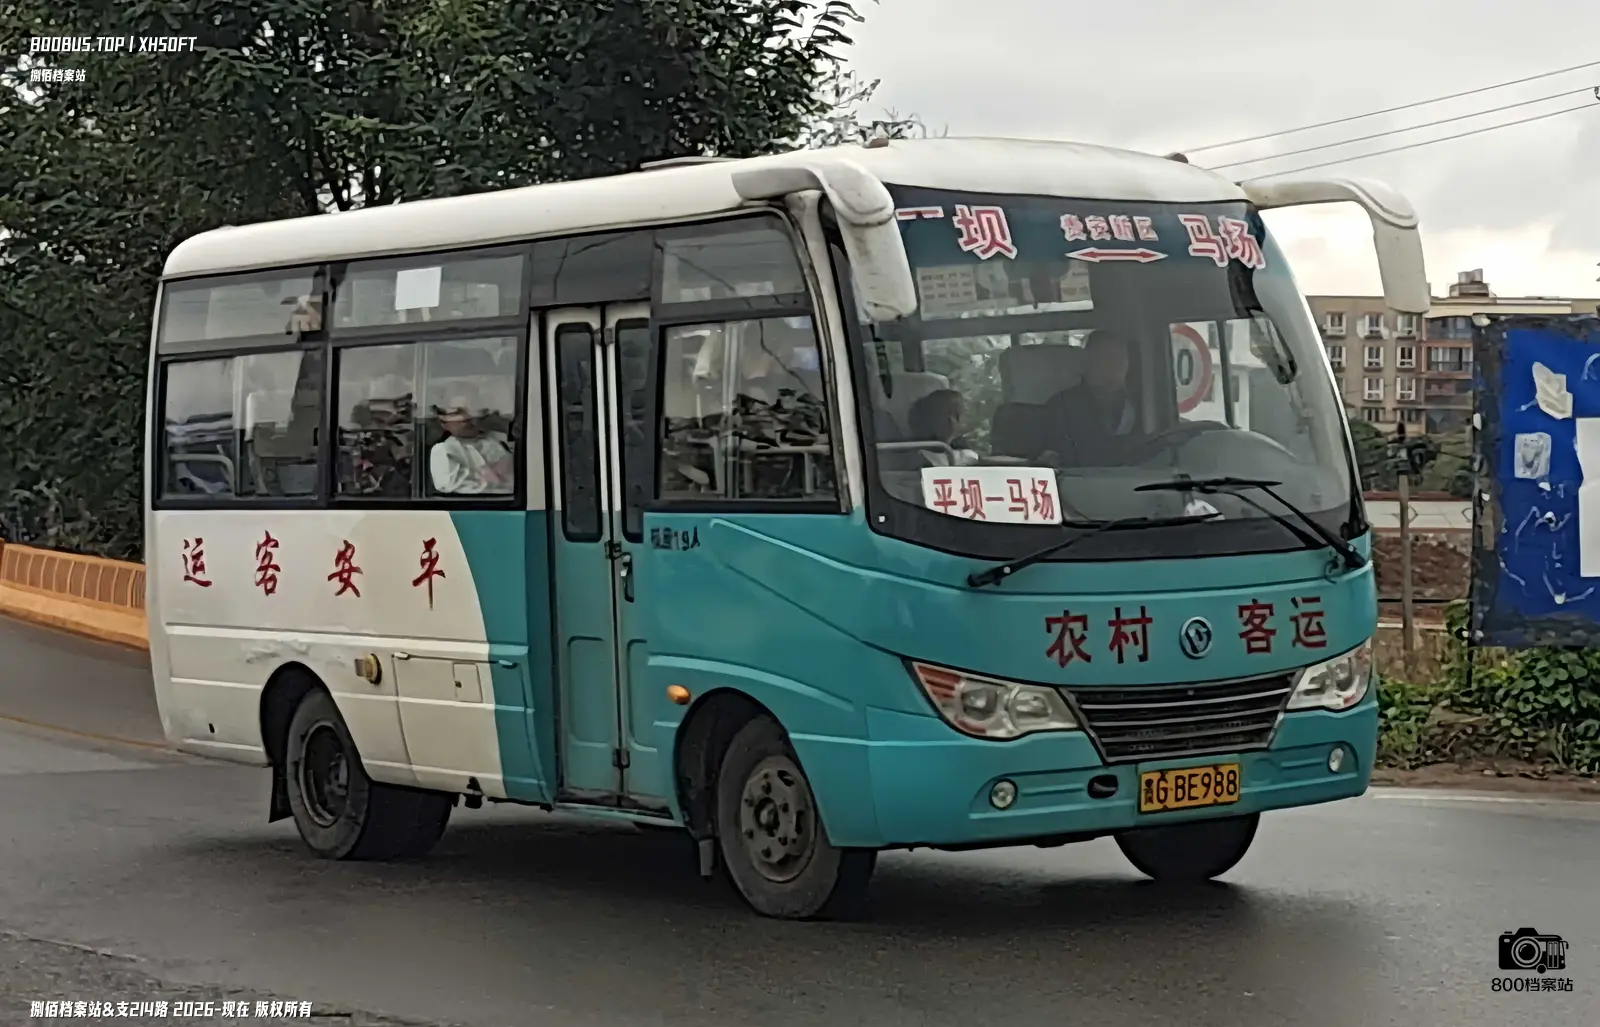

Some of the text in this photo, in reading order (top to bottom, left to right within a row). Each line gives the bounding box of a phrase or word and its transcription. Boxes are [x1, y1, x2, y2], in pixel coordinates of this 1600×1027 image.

[895, 204, 1018, 260] 坝
[1177, 213, 1267, 270] 马场
[1045, 596, 1328, 668] 农村 客运
